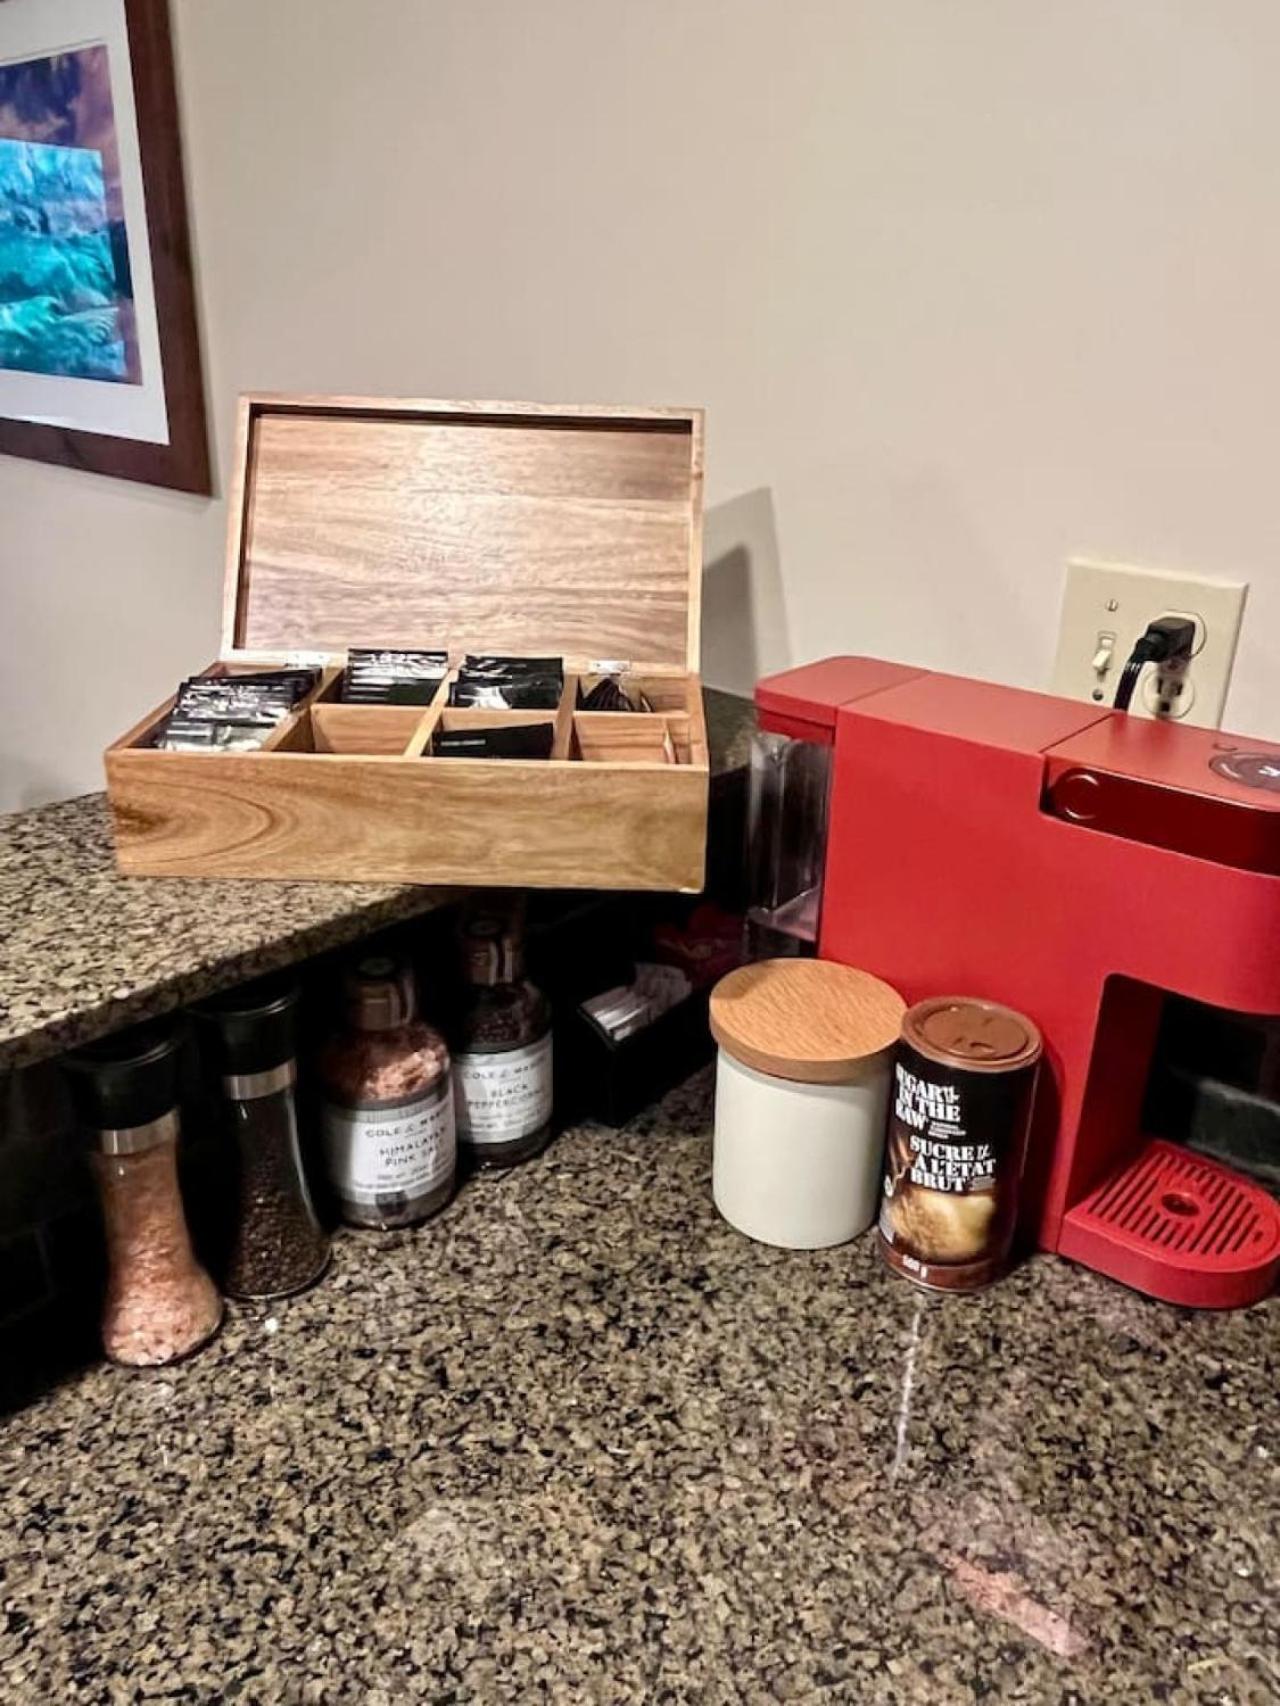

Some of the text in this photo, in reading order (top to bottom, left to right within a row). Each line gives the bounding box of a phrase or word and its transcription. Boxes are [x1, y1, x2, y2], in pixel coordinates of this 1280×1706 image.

[915, 1096, 960, 1122] THE
[910, 1135, 974, 1161] SUCRE
[910, 1167, 967, 1192] BRUT
